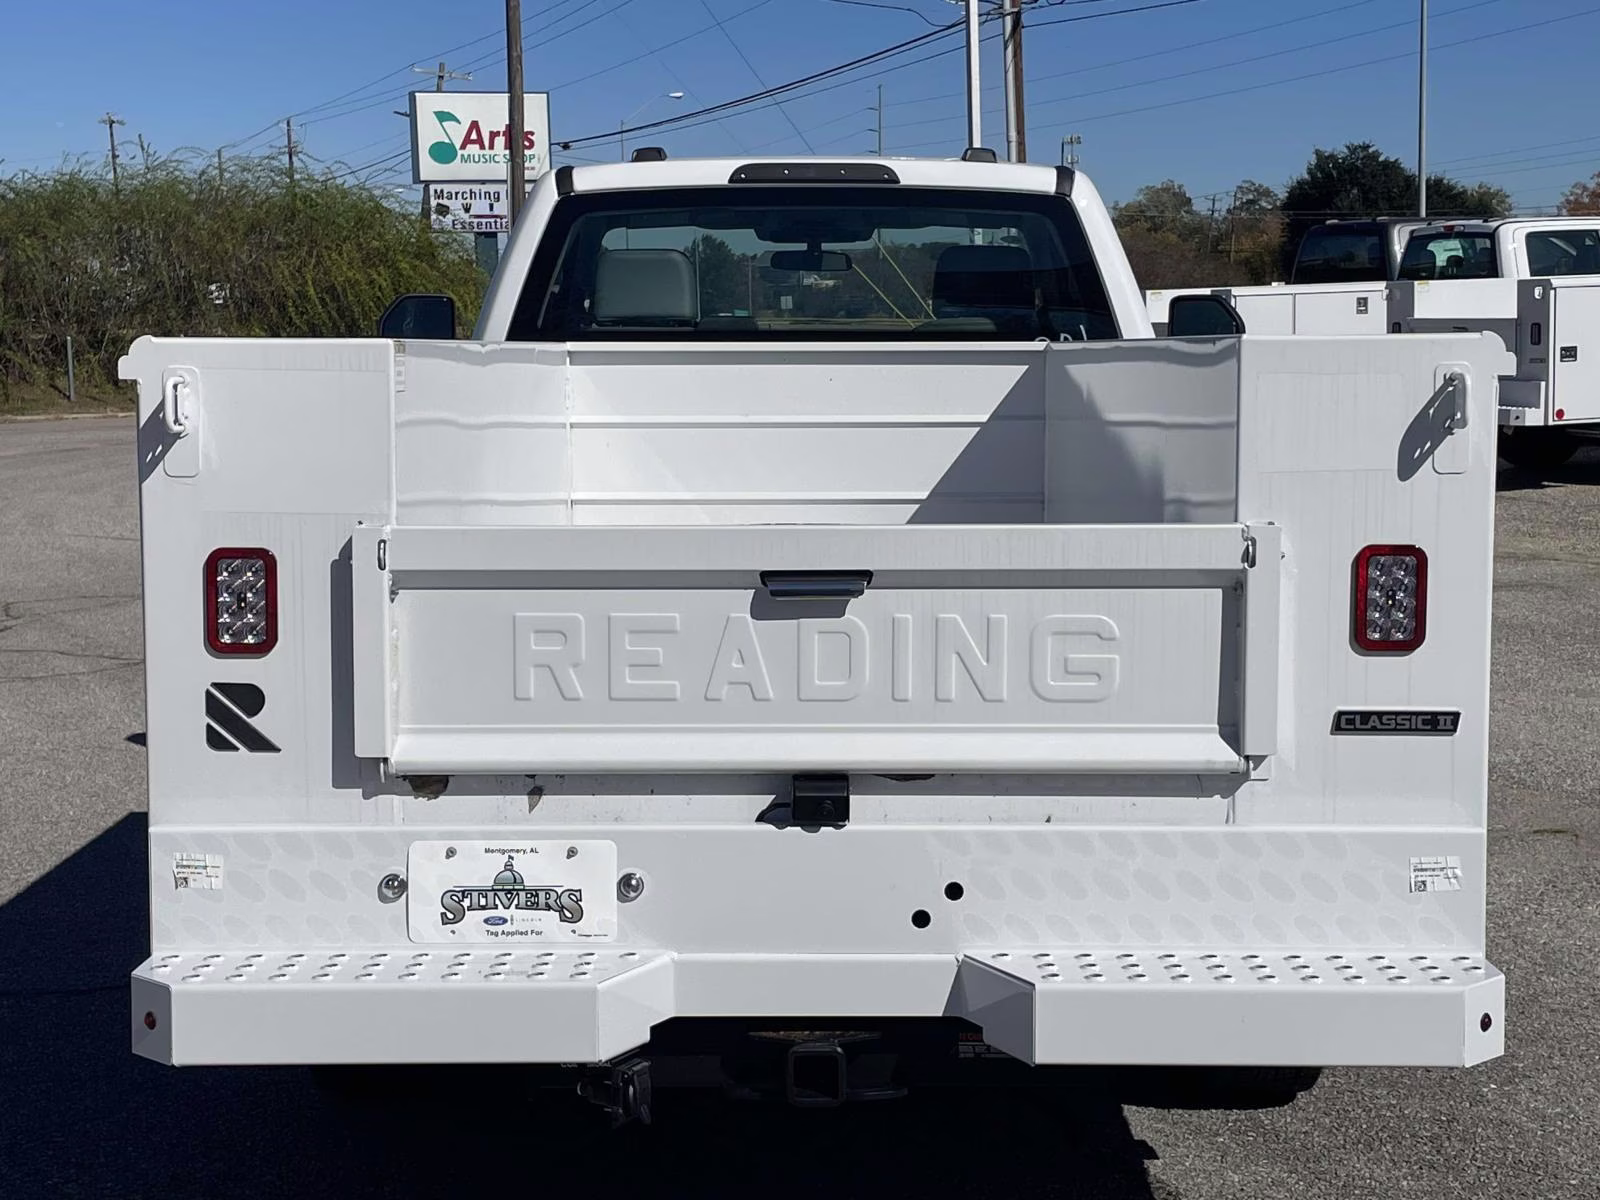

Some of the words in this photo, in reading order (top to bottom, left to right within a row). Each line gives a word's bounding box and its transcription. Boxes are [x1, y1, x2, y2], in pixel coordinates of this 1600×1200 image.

[460, 153, 501, 164] MUSIC
[503, 153, 536, 164] SP
[434, 189, 500, 202] Marching
[513, 613, 1121, 702] READING
[1340, 715, 1431, 729] CLASSIC
[1437, 715, 1454, 729] II
[441, 888, 584, 926] STIVERS
[485, 917, 507, 925] Ford
[485, 929, 498, 937] Tag
[502, 929, 529, 937] Applied
